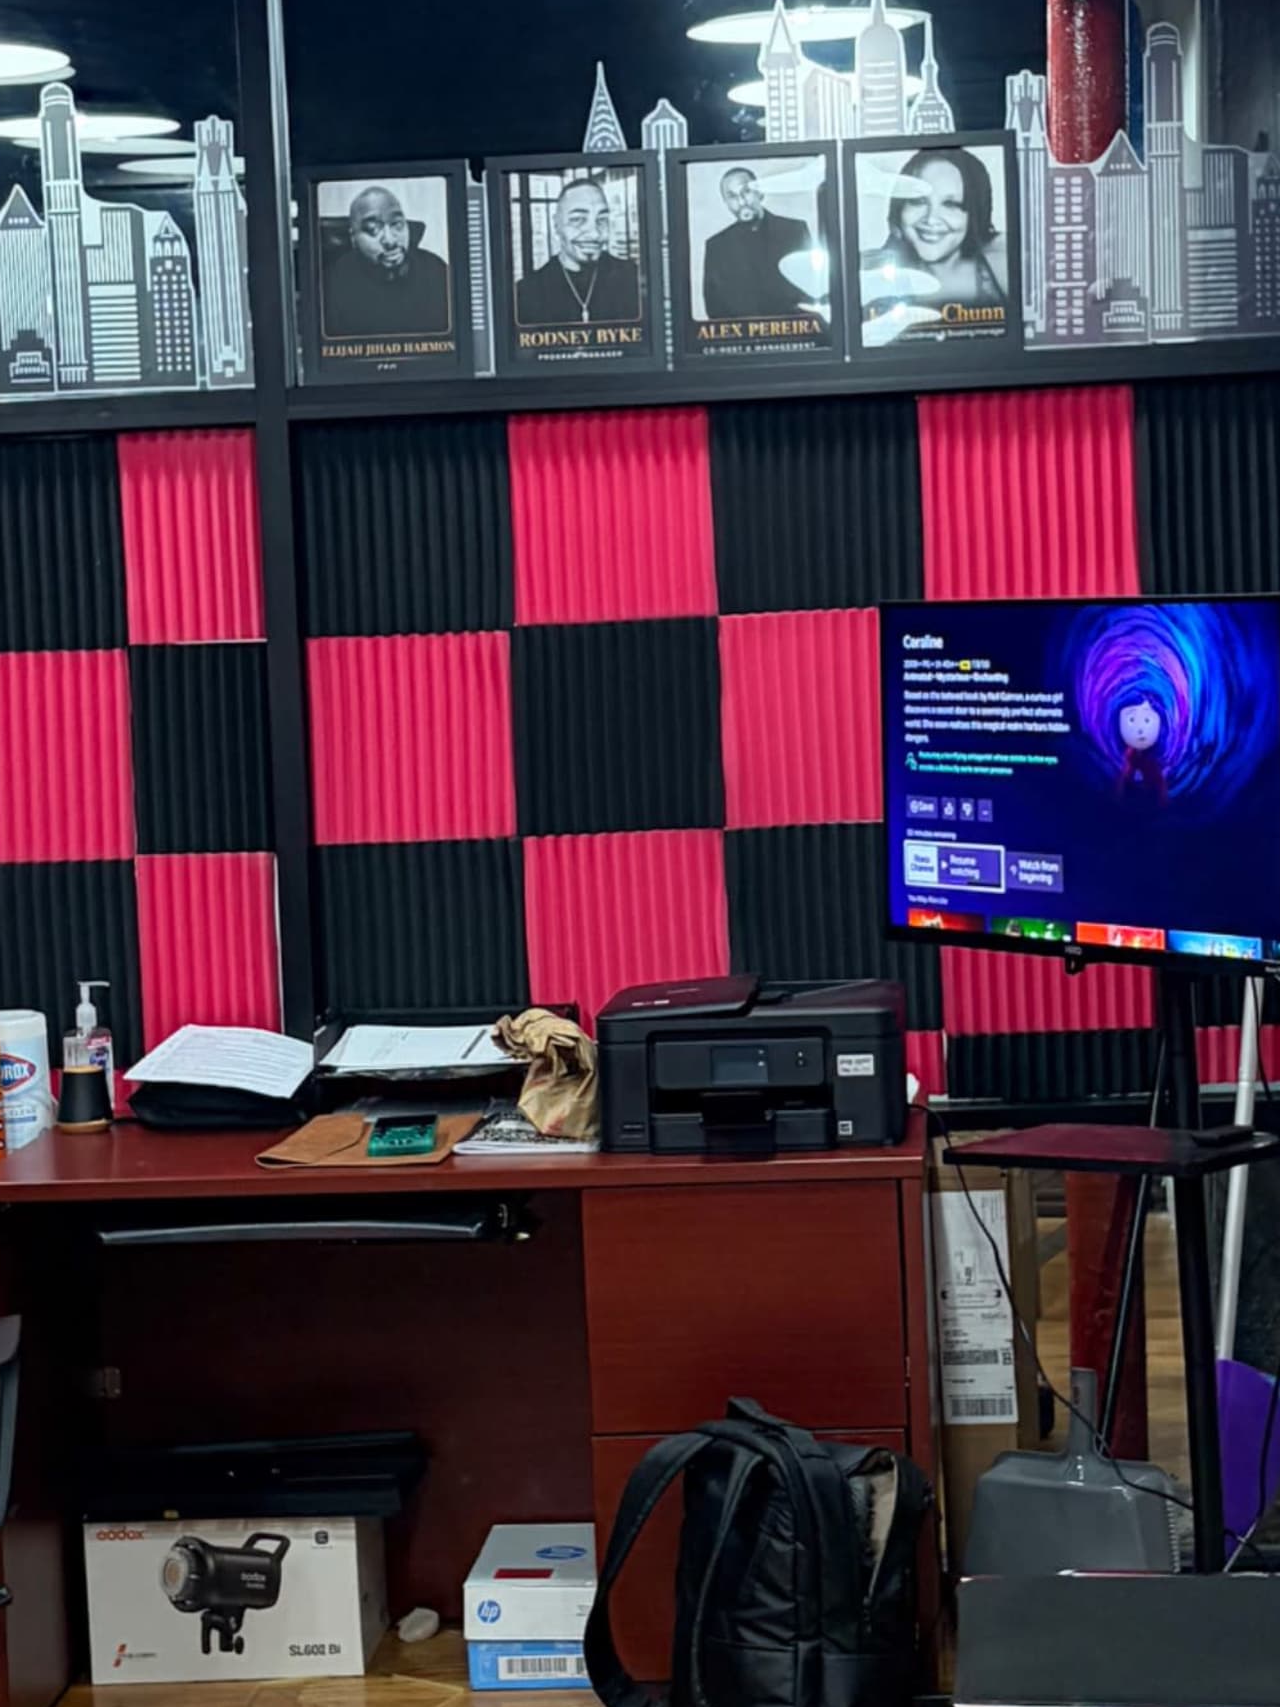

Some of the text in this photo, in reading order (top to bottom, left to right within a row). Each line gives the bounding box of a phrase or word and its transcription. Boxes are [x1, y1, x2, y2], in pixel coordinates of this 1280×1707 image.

[940, 302, 1006, 325] Chunn
[519, 327, 643, 348] RODNEY BYKE
[697, 318, 822, 340] ALEX PEREIRA
[404, 340, 457, 355] HARMON
[479, 1603, 498, 1623] hp
